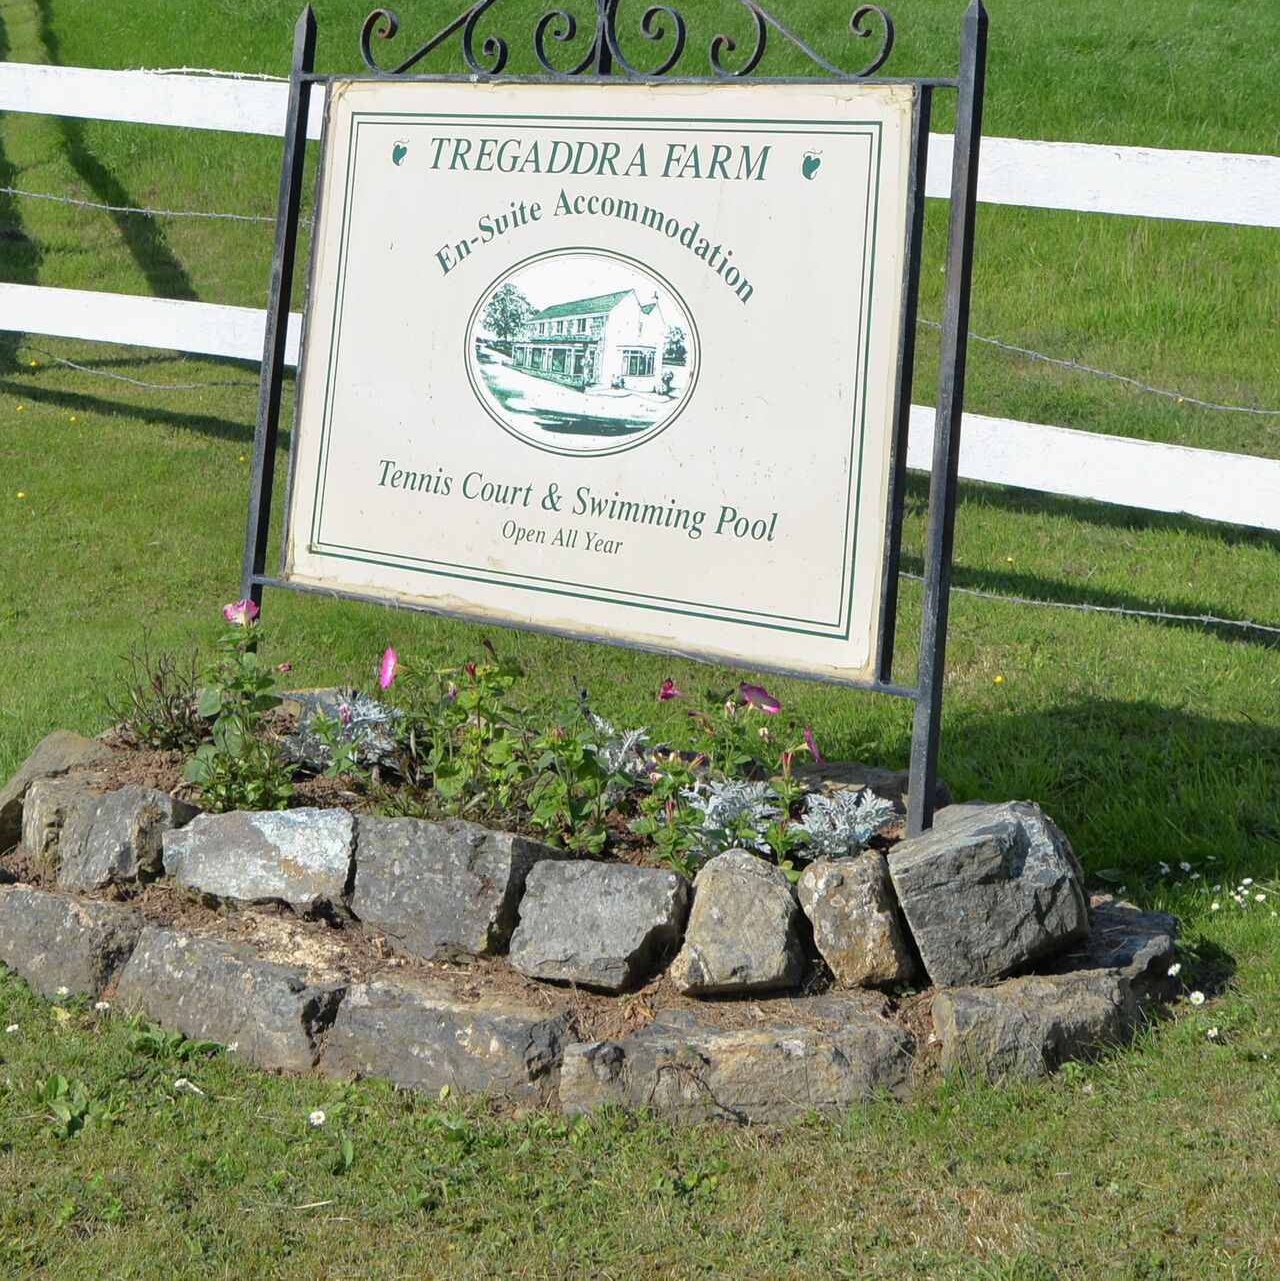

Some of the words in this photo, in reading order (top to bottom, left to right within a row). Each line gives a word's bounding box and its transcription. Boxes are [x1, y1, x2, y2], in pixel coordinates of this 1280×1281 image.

[430, 137, 649, 177] TREGADDRA
[660, 143, 772, 181] FARM
[435, 201, 542, 276] En-Suite
[553, 188, 754, 305] Accommodation
[378, 459, 453, 496] Tennis
[462, 471, 534, 507] Court
[541, 482, 563, 512] &
[571, 486, 706, 540] Swimming
[714, 505, 778, 542] Pool
[502, 520, 546, 546] Open
[551, 527, 578, 549] All
[585, 531, 624, 555] Year
